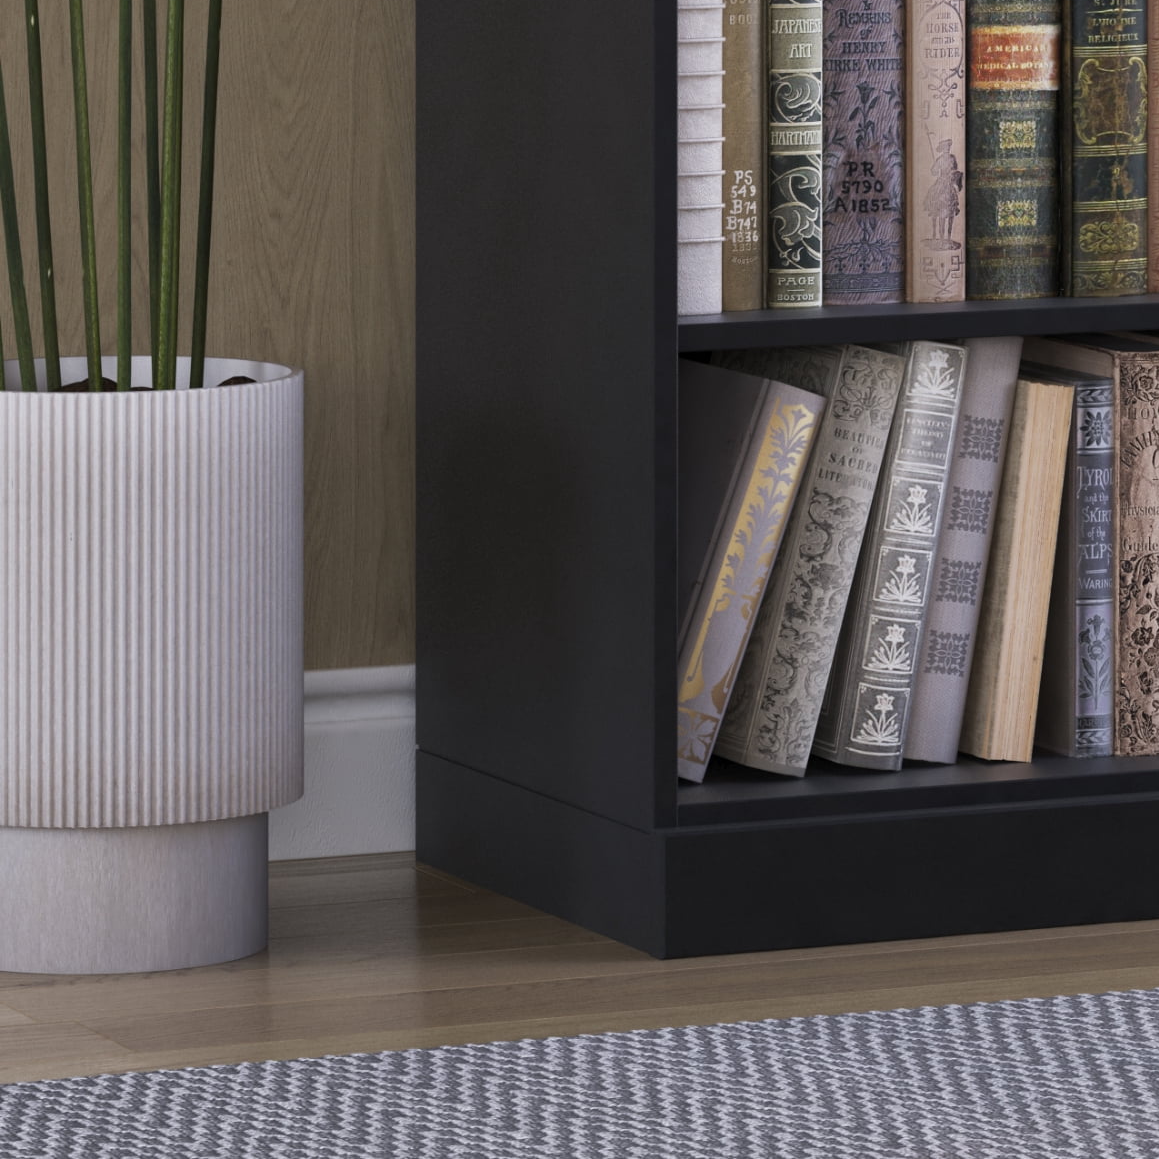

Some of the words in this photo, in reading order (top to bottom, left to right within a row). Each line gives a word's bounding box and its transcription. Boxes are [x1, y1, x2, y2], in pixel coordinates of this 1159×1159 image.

[925, 22, 960, 33] HORSE
[789, 43, 813, 58] ART
[842, 41, 887, 54] HENRY
[925, 47, 961, 59] RIDER
[865, 57, 903, 71] WHITE
[731, 185, 757, 198] 549
[841, 180, 884, 194] 5790
[777, 276, 816, 286] PAGE
[777, 293, 815, 301] BOSTON
[828, 453, 880, 474] SACRED
